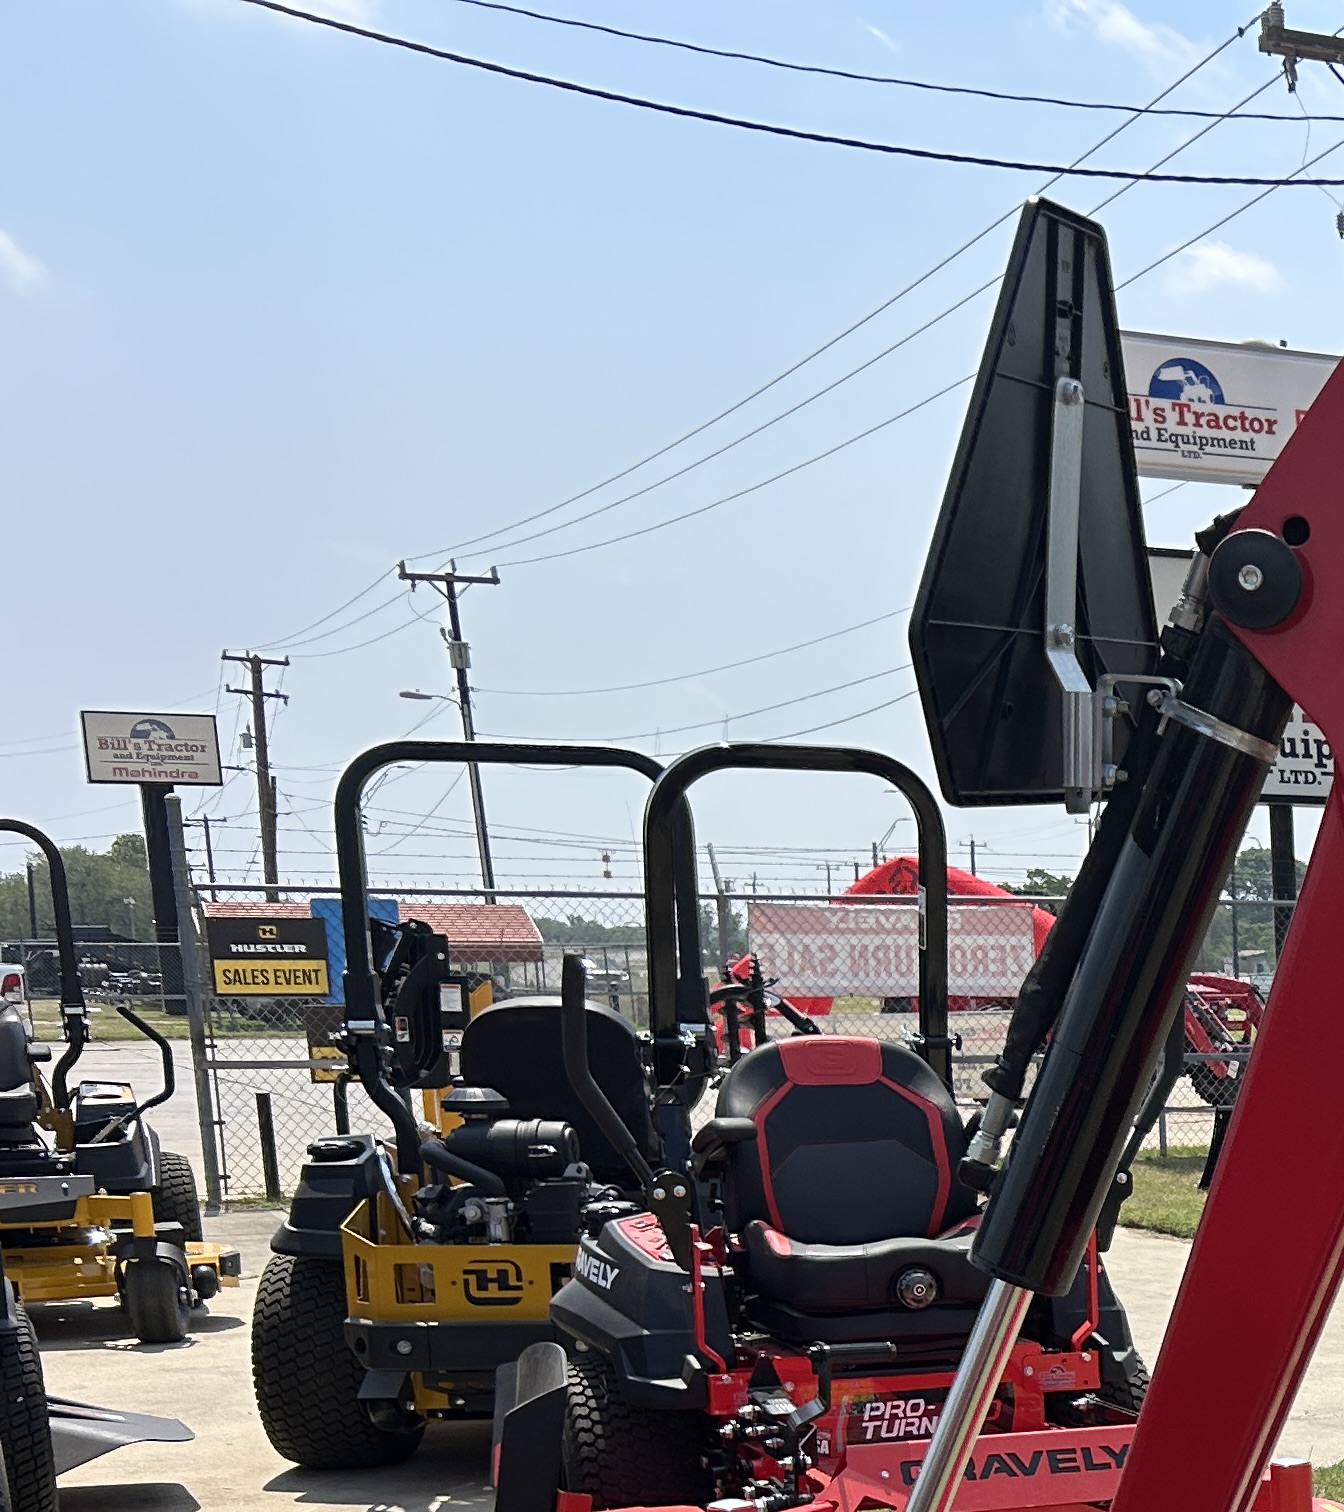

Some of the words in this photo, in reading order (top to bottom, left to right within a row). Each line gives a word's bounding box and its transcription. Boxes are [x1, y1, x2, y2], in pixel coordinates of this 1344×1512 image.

[1171, 401, 1279, 436] Tractor
[1131, 427, 1151, 442] nd
[1156, 427, 1257, 451] Equipment
[97, 737, 142, 751] Bill's
[144, 740, 208, 753] Tractor
[112, 752, 134, 760] and
[135, 752, 195, 763] Equipment
[1278, 769, 1322, 786] LTD.
[229, 943, 308, 954] HUSTLER
[222, 968, 271, 986] SALES
[273, 968, 322, 986] EVENT
[863, 1398, 936, 1422] PRO-
